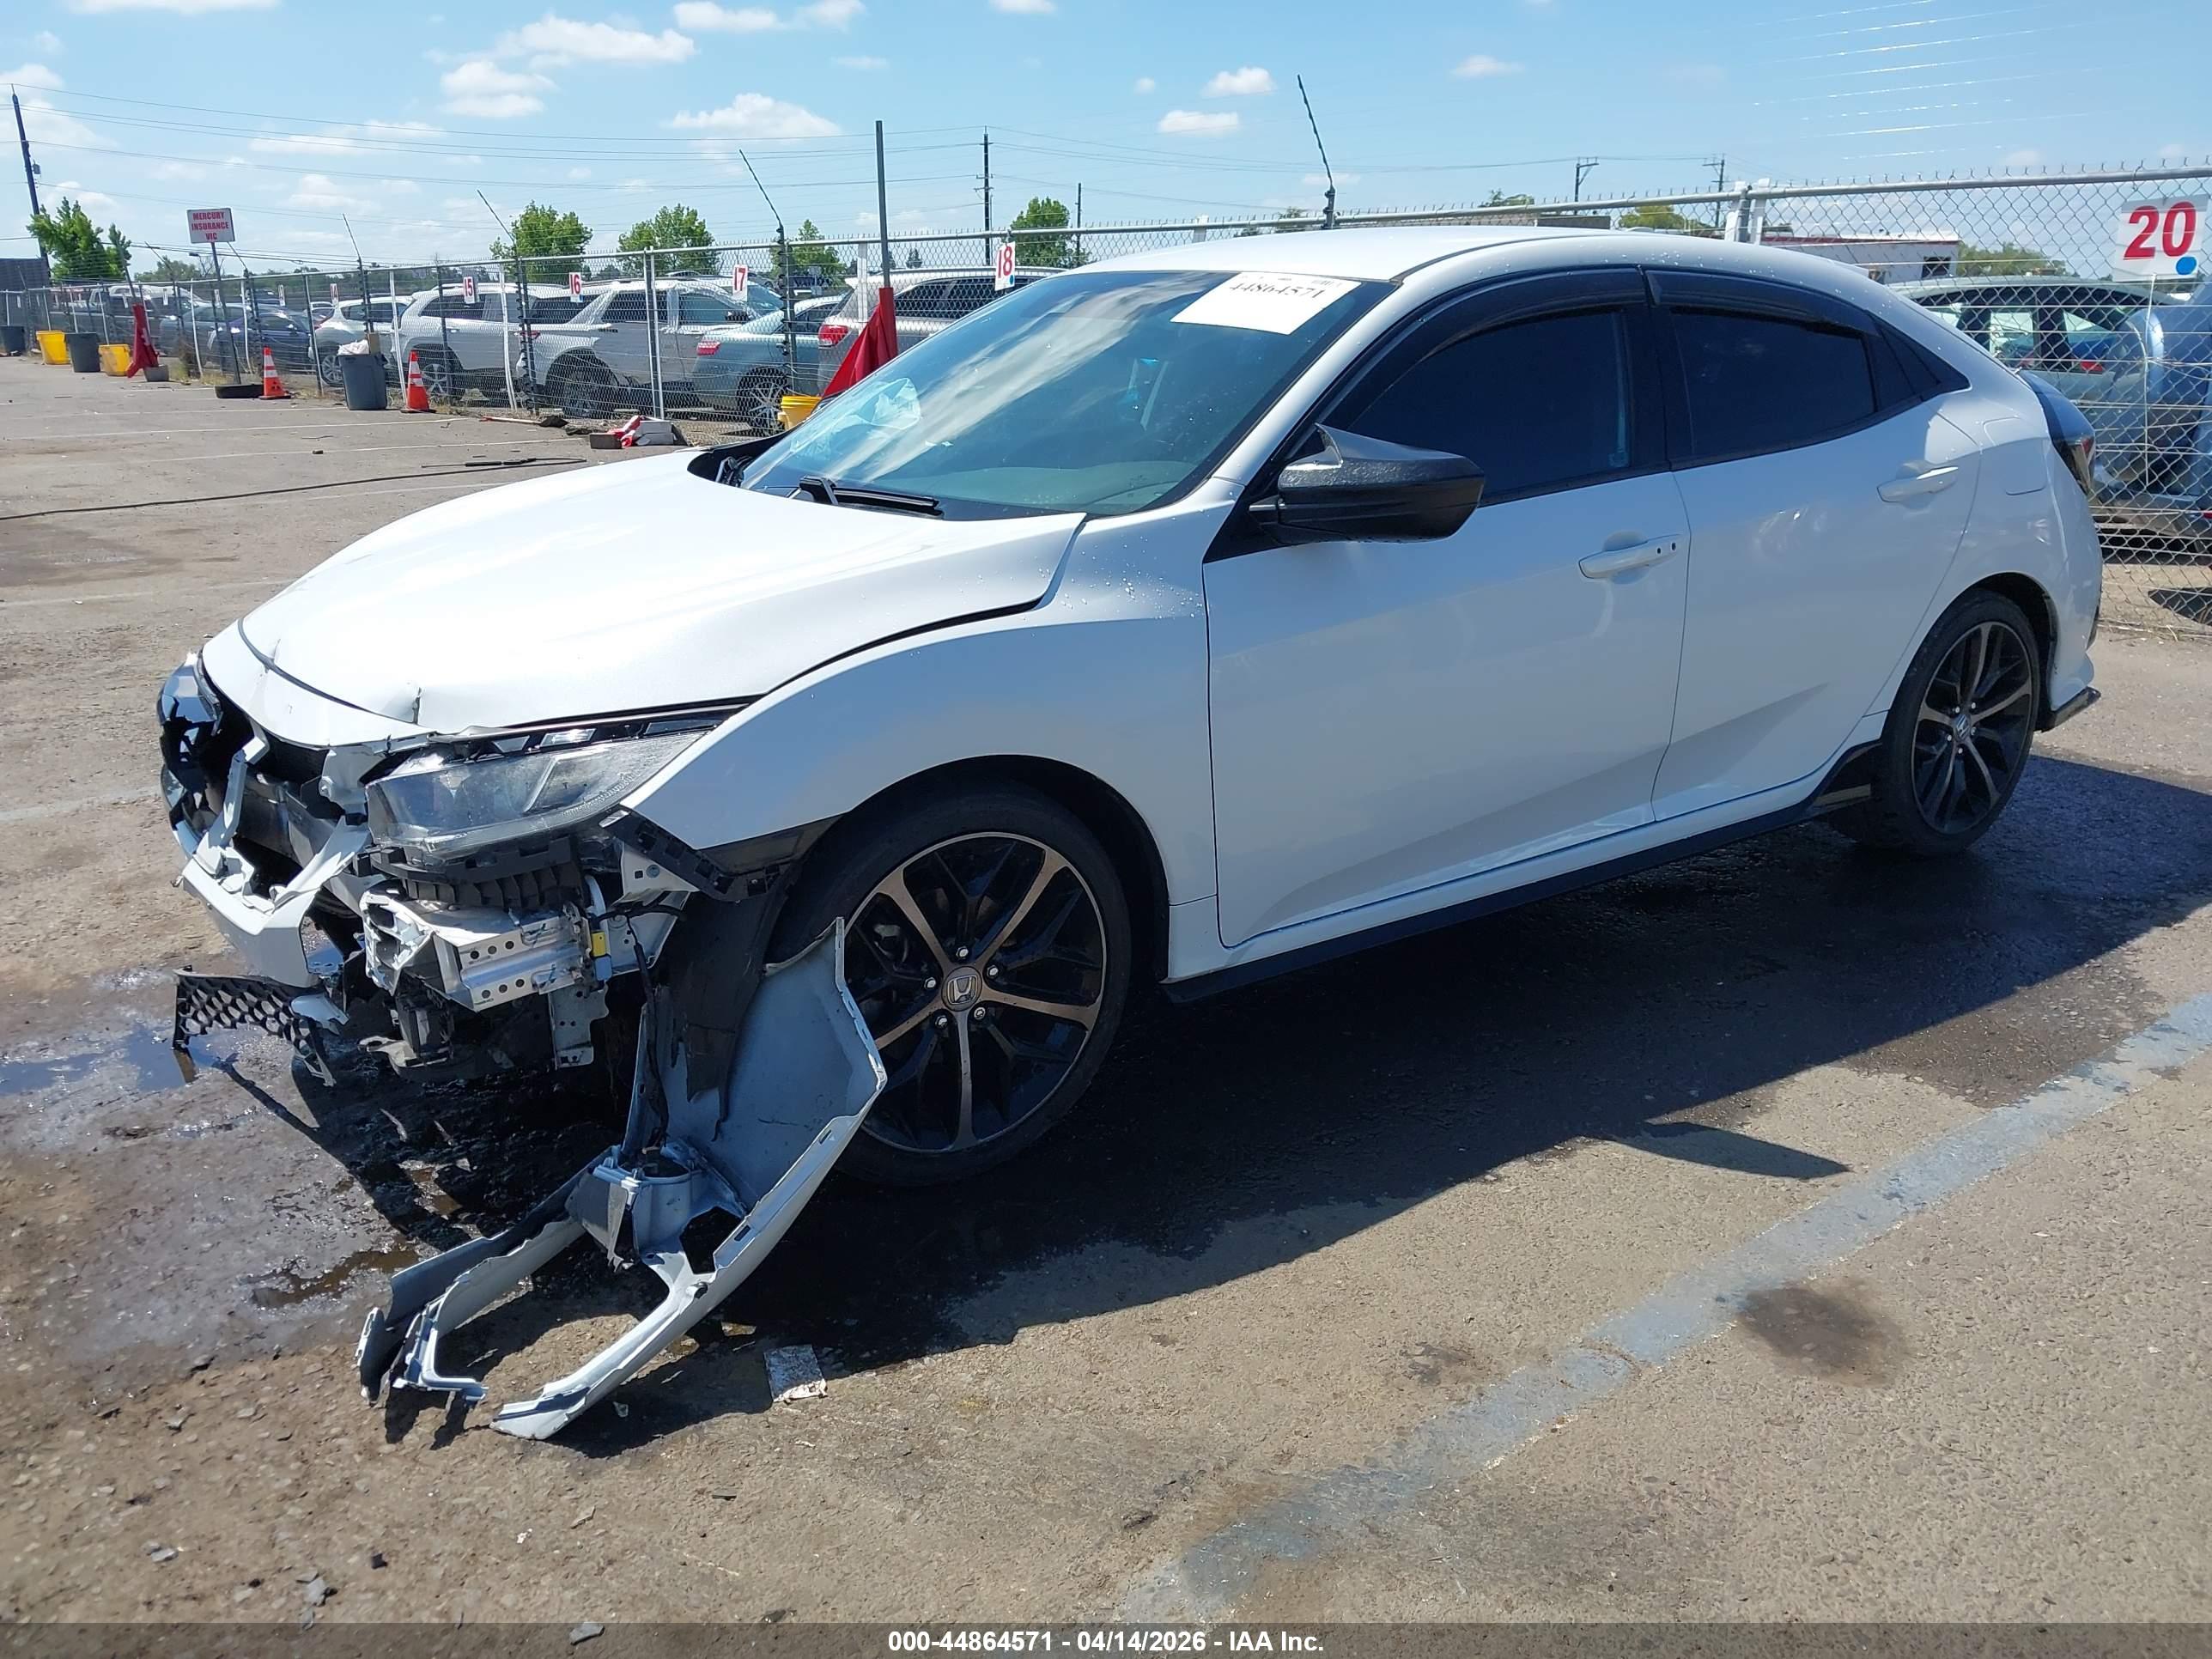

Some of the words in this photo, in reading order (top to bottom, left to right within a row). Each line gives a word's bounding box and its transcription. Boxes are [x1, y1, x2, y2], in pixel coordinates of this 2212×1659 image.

[192, 211, 225, 221] MERCURY
[191, 222, 229, 231] INSURANCE
[205, 232, 217, 240] VIC
[2123, 201, 2197, 260] 20
[998, 246, 1012, 278] 18
[464, 277, 473, 296] 15
[569, 274, 581, 295] 16
[734, 267, 745, 291] 17
[1230, 283, 1326, 298] 44864571
